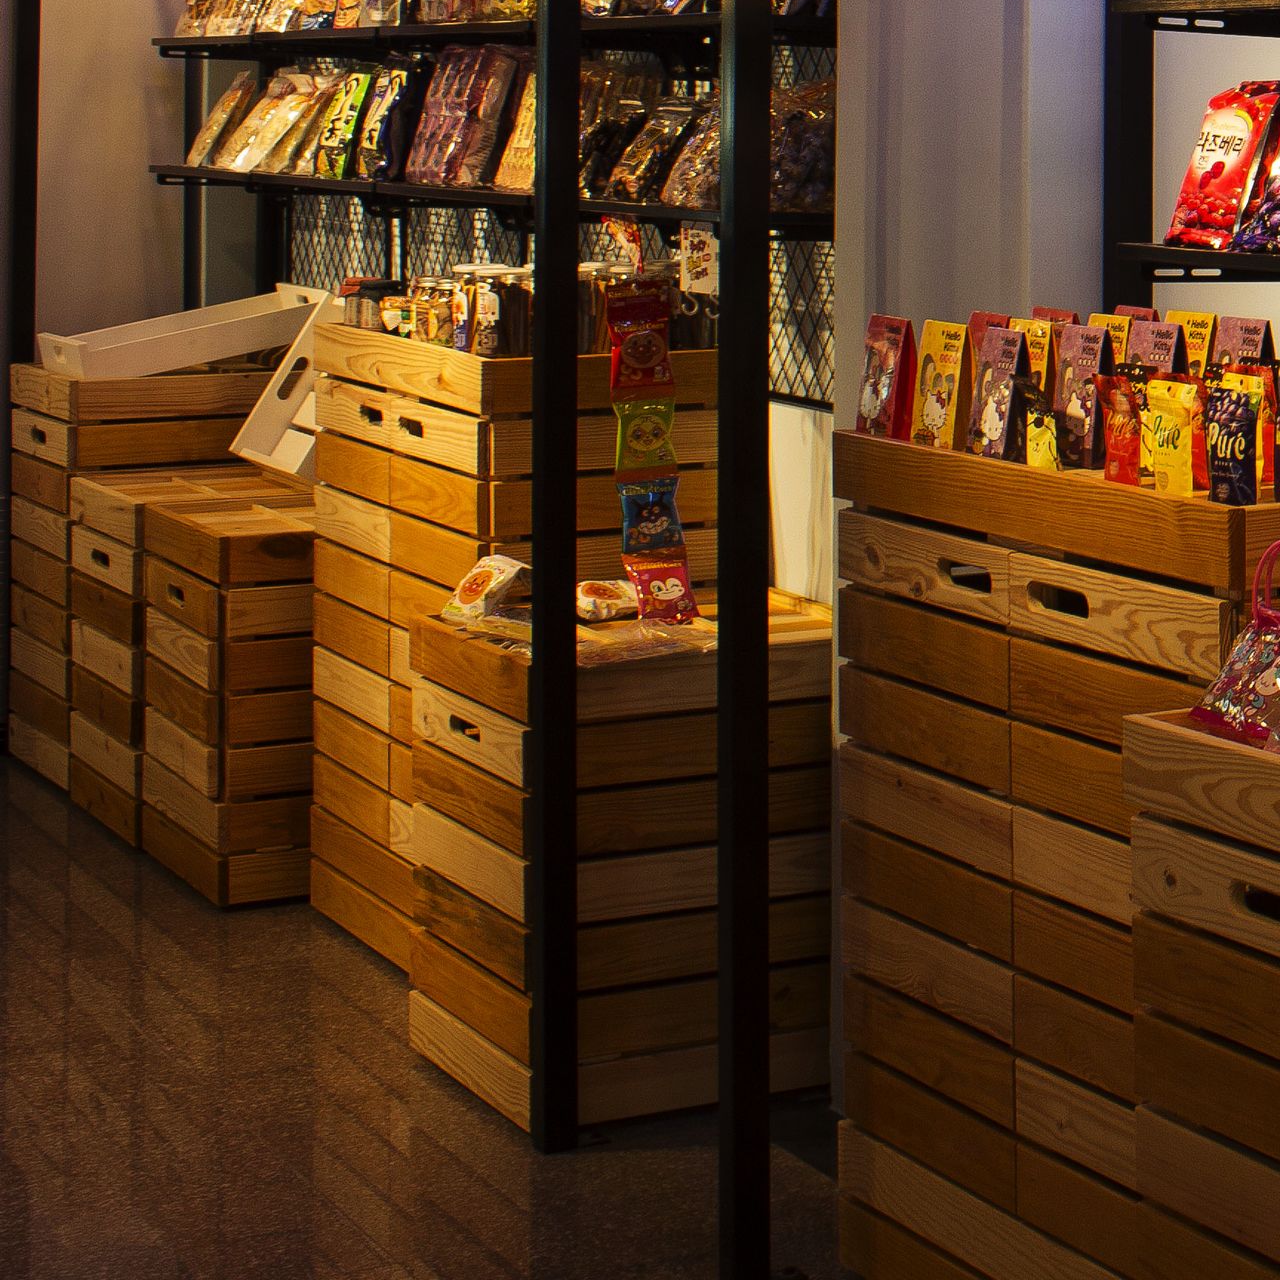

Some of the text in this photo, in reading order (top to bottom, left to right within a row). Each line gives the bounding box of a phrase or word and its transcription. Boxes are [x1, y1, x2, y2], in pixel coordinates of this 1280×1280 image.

[1191, 319, 1209, 330] Hello
[1188, 331, 1207, 343] Kitty
[1207, 420, 1246, 460] Puré
